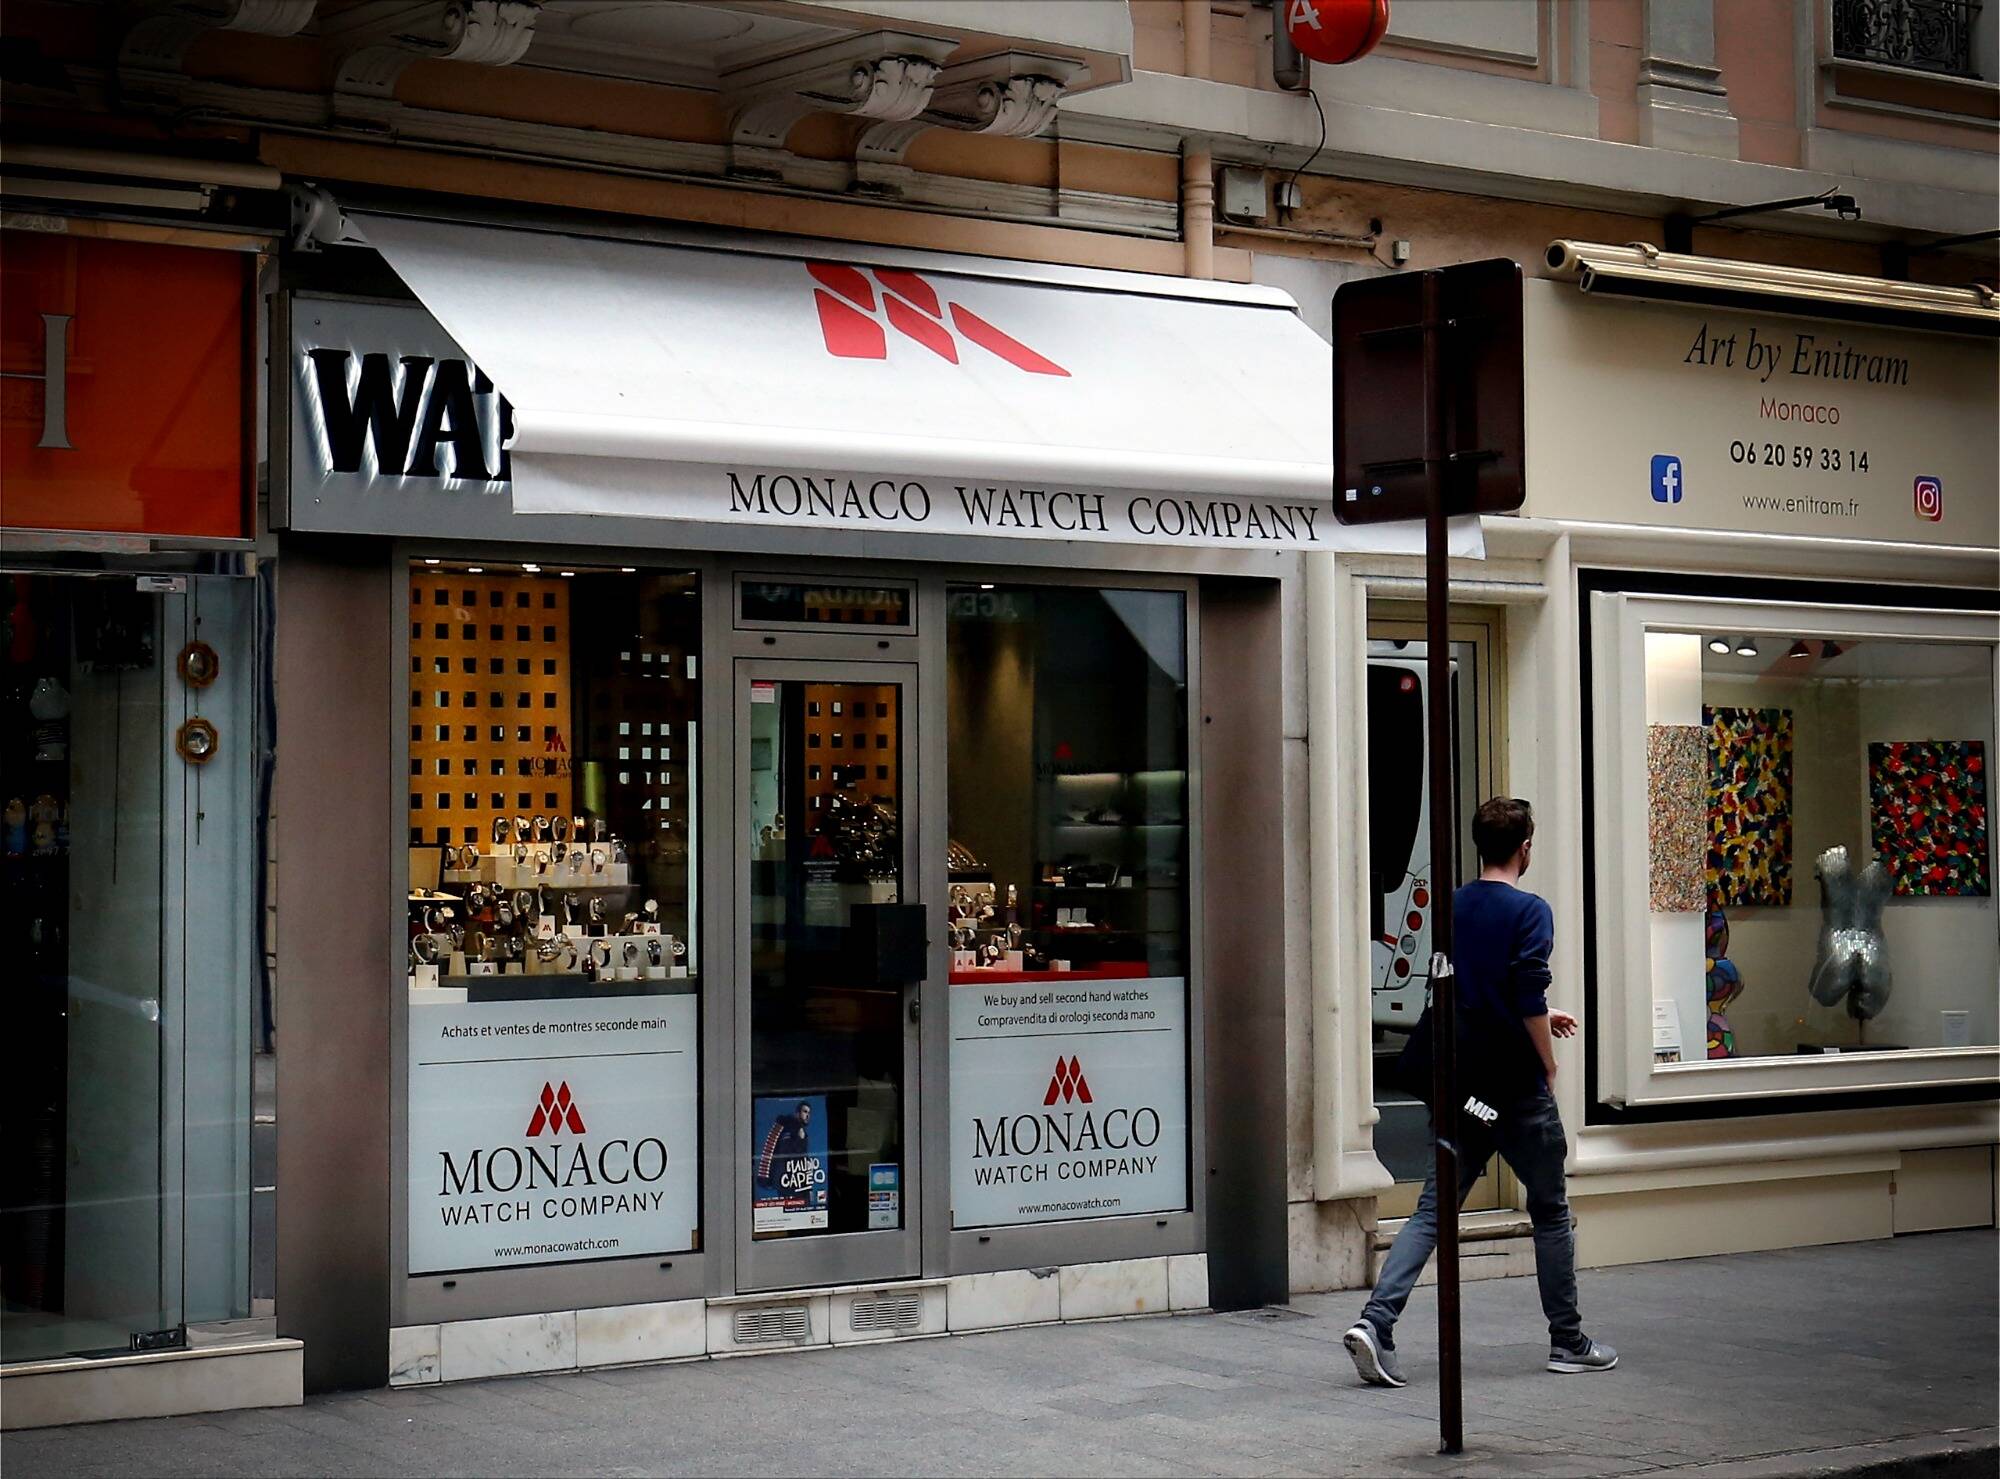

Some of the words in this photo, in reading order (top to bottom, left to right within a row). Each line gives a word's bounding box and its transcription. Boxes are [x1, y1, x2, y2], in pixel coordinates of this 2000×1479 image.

[1684, 323, 1736, 367] Art
[1745, 328, 1781, 383] by
[1790, 334, 1909, 385] Enitram
[1760, 397, 1840, 425] Monaco
[1764, 443, 1785, 467] 20
[1793, 446, 1813, 468] 59
[1821, 448, 1841, 471] 33
[1849, 451, 1869, 473] 14
[726, 472, 930, 522] MONACO
[955, 486, 1109, 532] WATCH
[1128, 497, 1318, 542] COMPANY
[1743, 495, 1859, 517] www.enitram.fr
[984, 995, 999, 1006] We
[1000, 994, 1017, 1008] buy
[1020, 993, 1037, 1005] and
[1039, 992, 1054, 1004] sell
[1055, 991, 1087, 1003] second
[1089, 990, 1111, 1002] hand
[1113, 990, 1149, 1001] watches
[441, 1025, 478, 1038] Achats
[481, 1025, 492, 1036] et
[494, 1024, 530, 1036] ventes
[532, 1022, 546, 1034] de
[549, 1021, 593, 1033] montres
[595, 1018, 639, 1031] seconde
[641, 1017, 667, 1029] main
[978, 1012, 1047, 1028] Compravendita
[1048, 1011, 1058, 1023] di
[1059, 1010, 1091, 1024] orologi
[1092, 1009, 1129, 1021] seconda
[1130, 1010, 1156, 1020] mano
[1464, 1096, 1498, 1121] MIP
[972, 1107, 1160, 1158] MONACO
[438, 1137, 668, 1196] MONACO
[975, 1164, 1048, 1185] WATCH
[1058, 1156, 1157, 1180] COMPANY
[441, 1201, 530, 1226] WATCH
[543, 1191, 664, 1219] COMPANY
[1018, 1197, 1120, 1214] www.monacowatch.com
[494, 1238, 619, 1257] www.monacowatch.com
